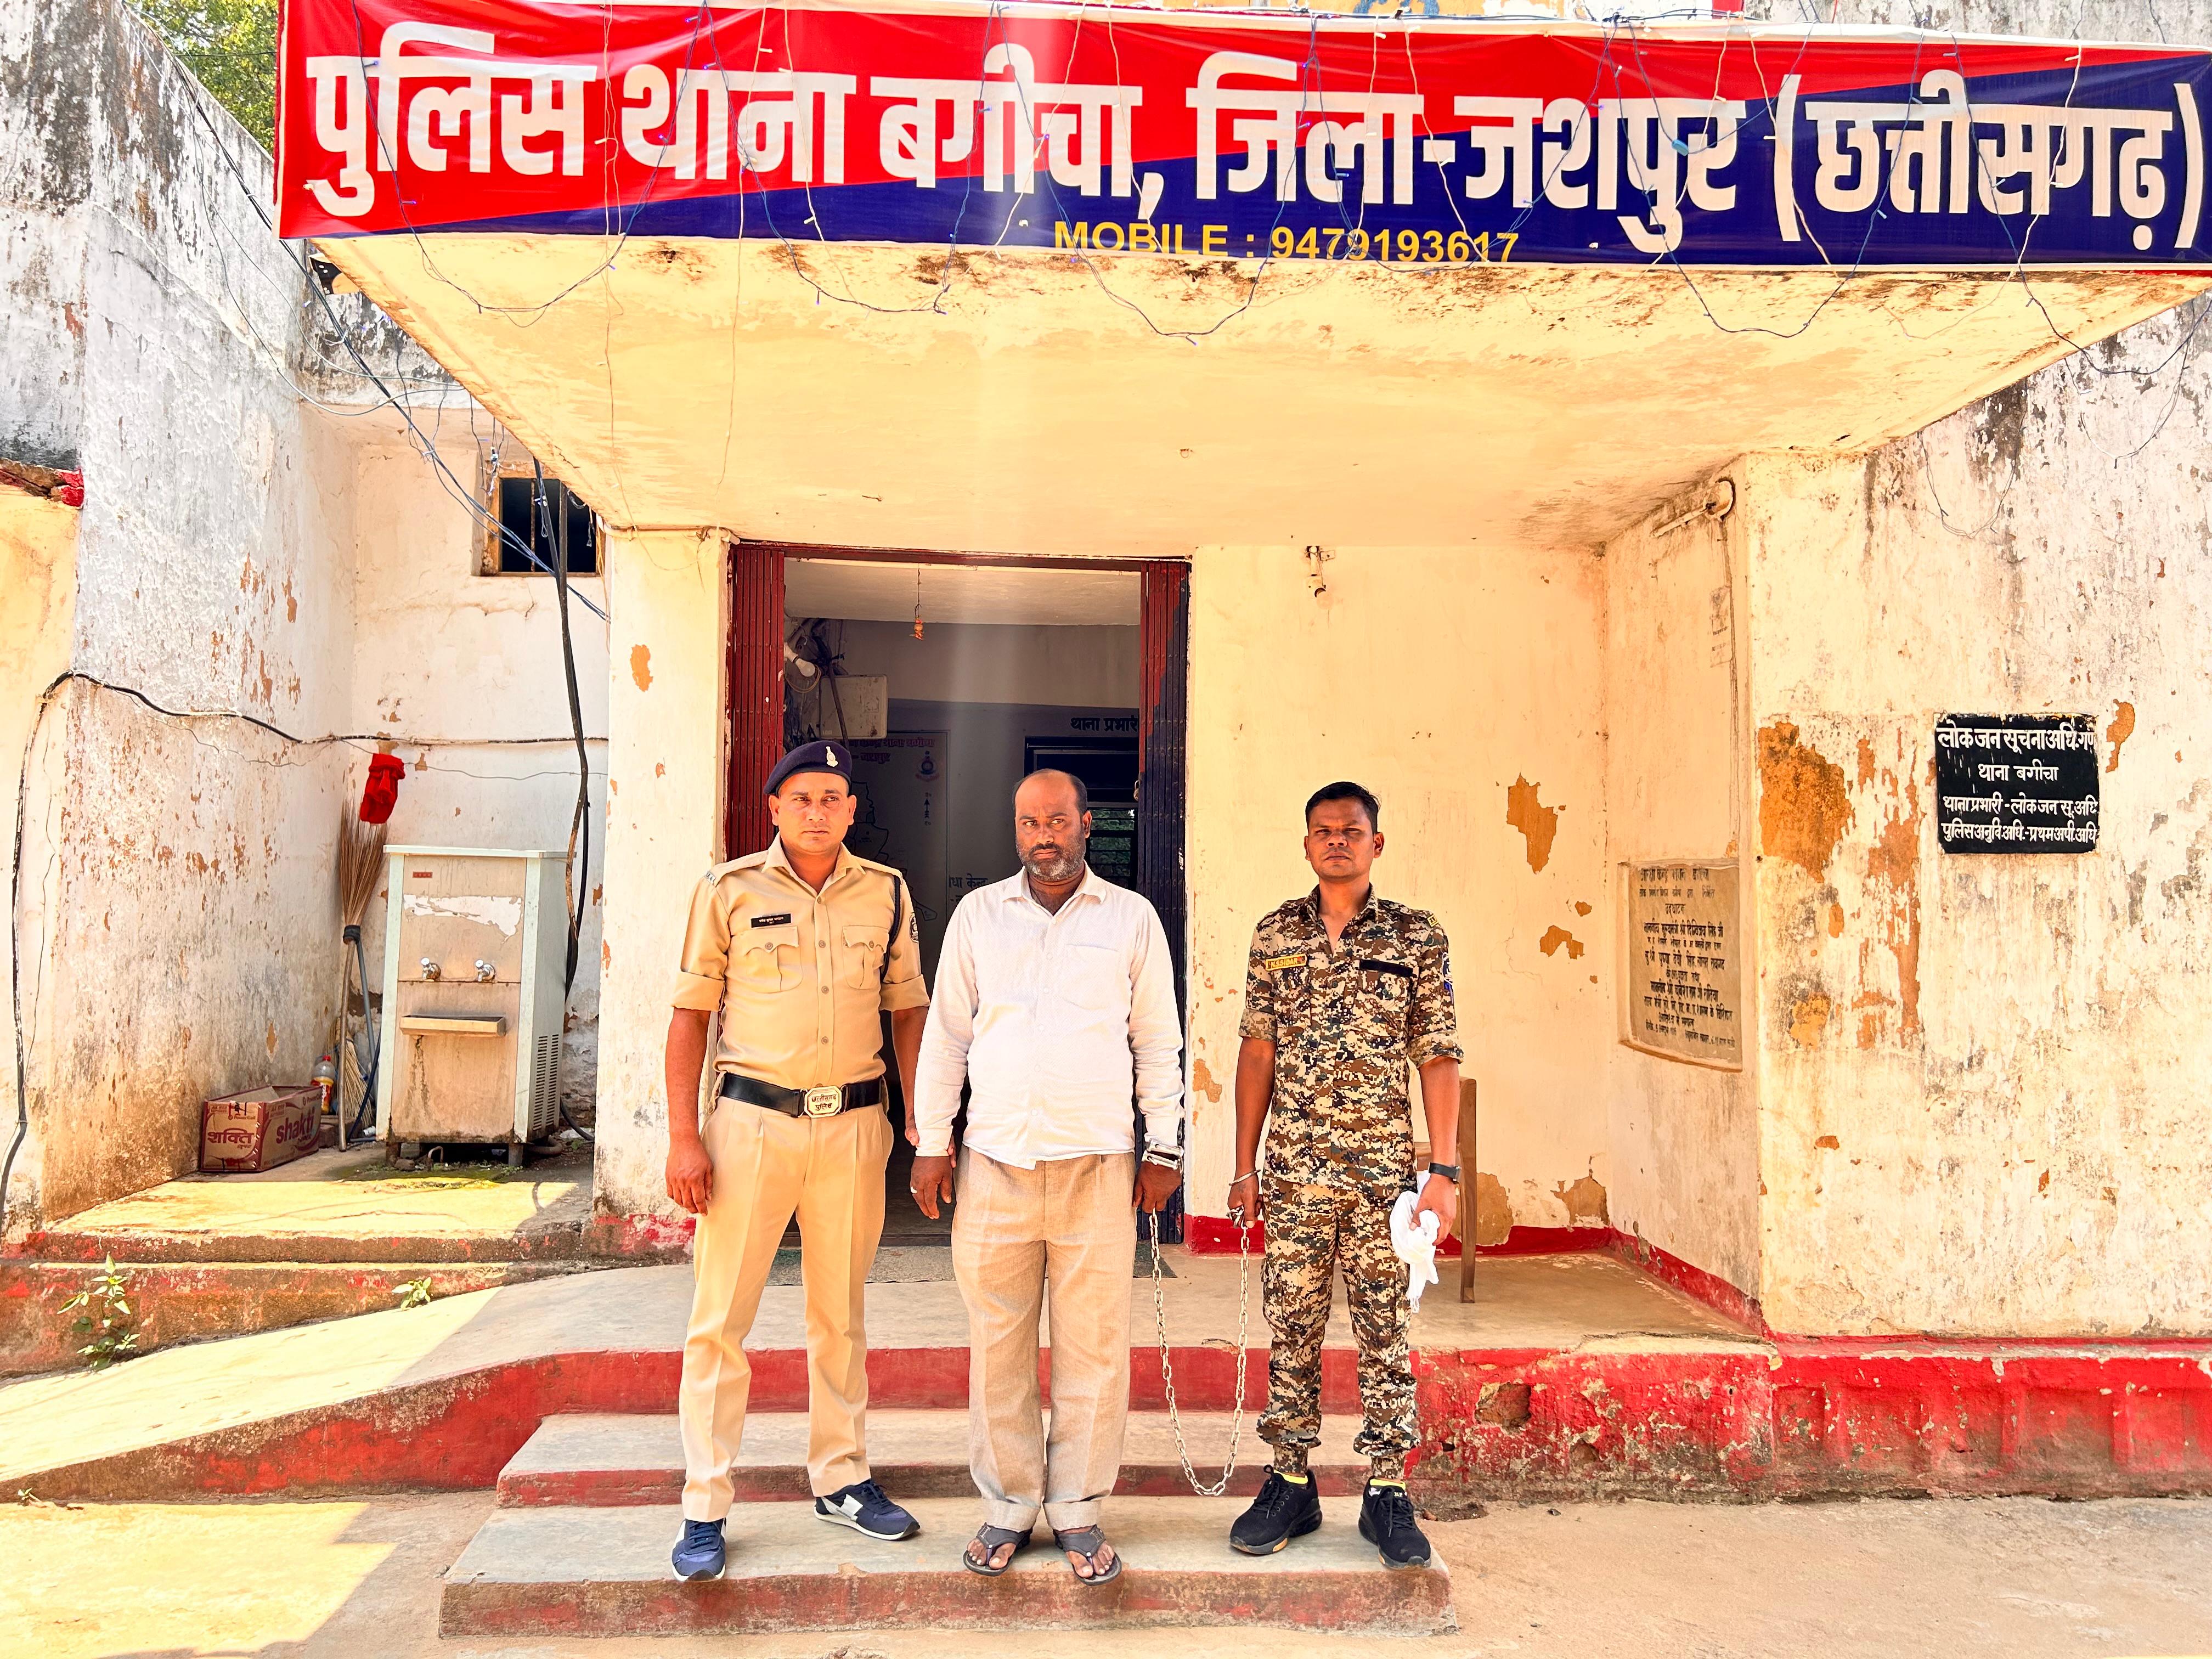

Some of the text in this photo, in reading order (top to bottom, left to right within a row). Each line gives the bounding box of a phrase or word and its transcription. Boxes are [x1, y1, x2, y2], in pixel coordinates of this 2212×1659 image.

[306, 21, 597, 217] पुलिस
[620, 64, 856, 184] थाना
[871, 43, 1165, 221] बगीचा,
[1774, 69, 2204, 251] (छत्तीसगढ़)
[1054, 220, 1229, 257] MOBILE
[1272, 226, 1519, 262] 9479193617
[1071, 717, 1100, 731] थाना
[1936, 719, 1973, 748] लोक
[1974, 729, 2002, 749] जन
[2002, 729, 2046, 754] सूचना
[1978, 758, 2059, 781] थाना बगीचा
[2011, 792, 2036, 814] लोक
[2038, 799, 2059, 815] जन
[207, 1128, 254, 1144] शक्ति
[276, 1107, 315, 1144] shakti
